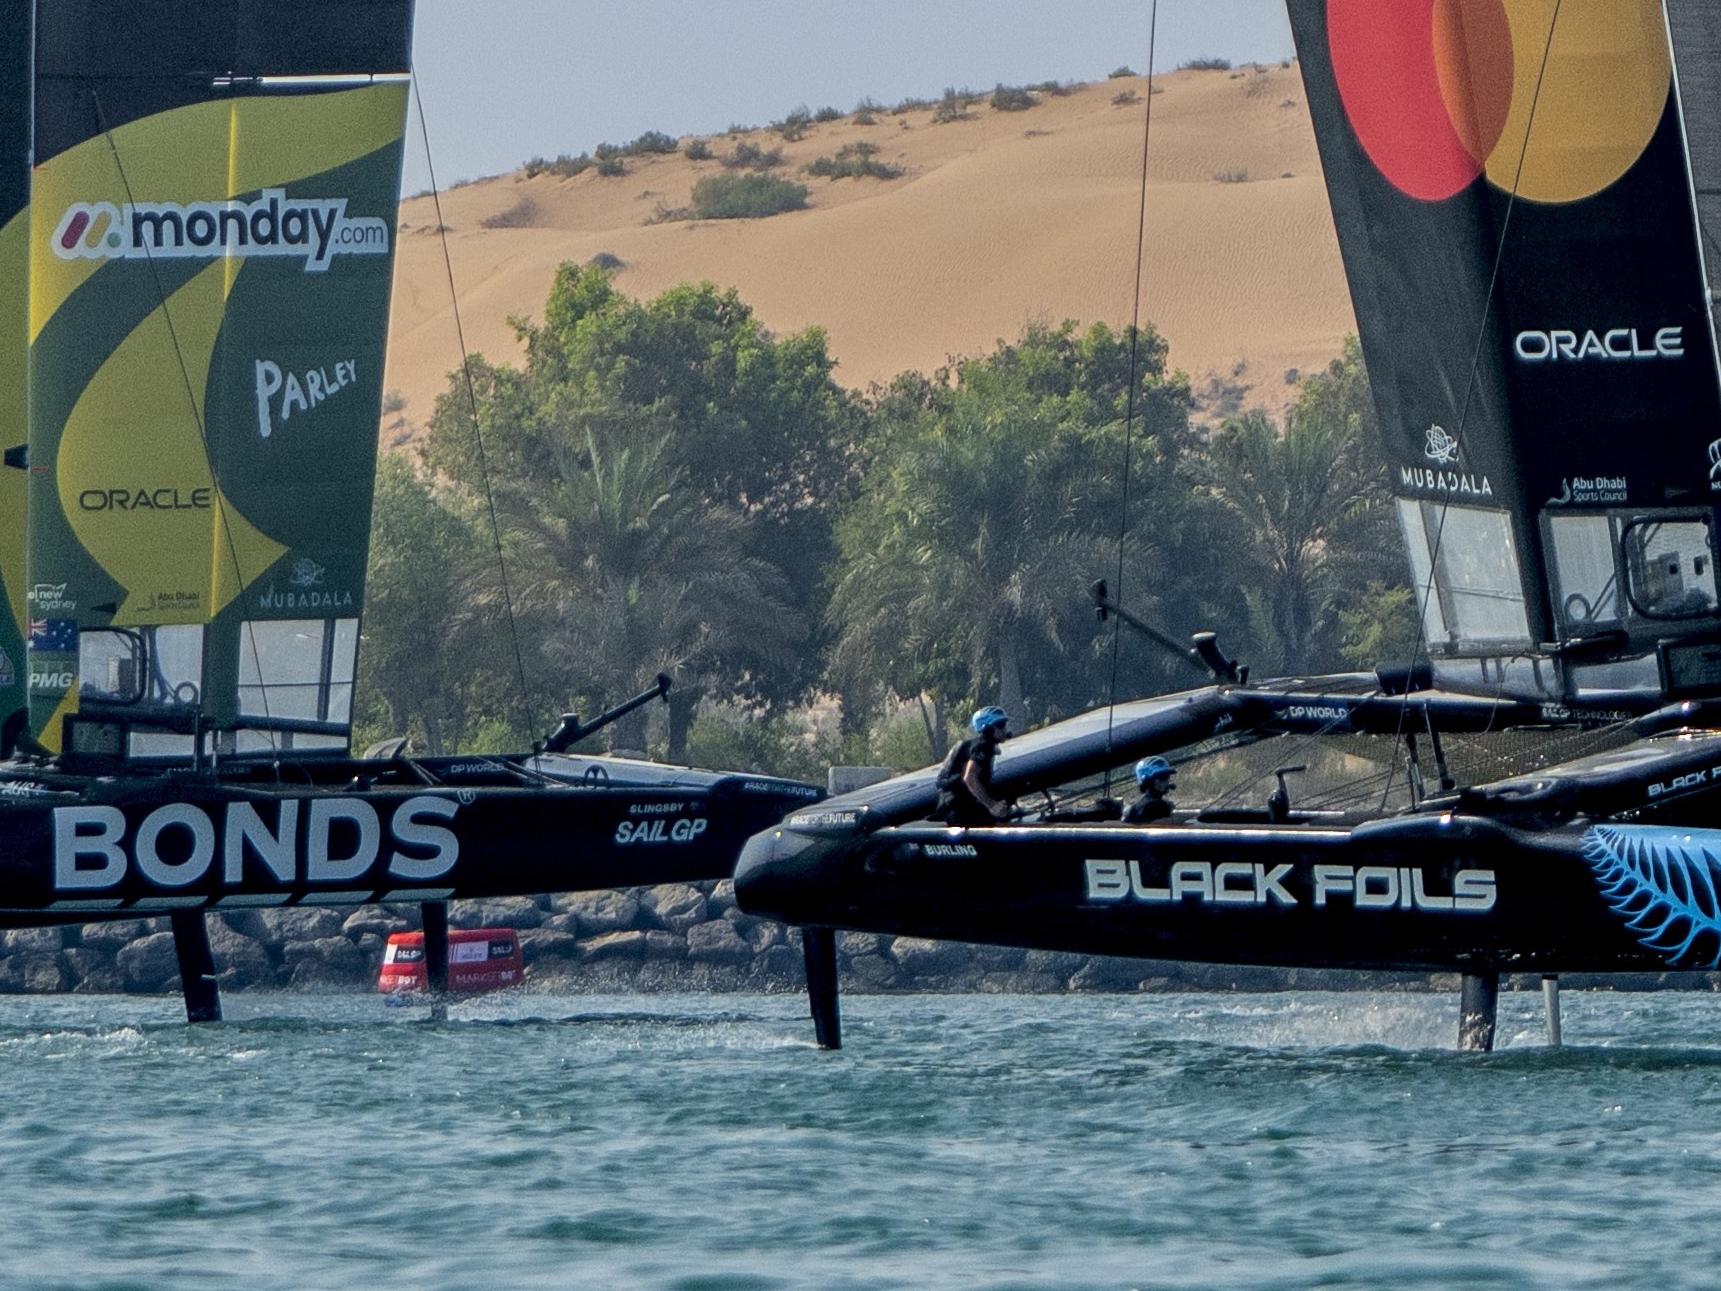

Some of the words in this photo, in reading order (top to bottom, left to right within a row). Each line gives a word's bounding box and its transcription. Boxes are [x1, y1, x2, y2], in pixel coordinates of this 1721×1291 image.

[132, 198, 385, 262] monday.com
[1516, 327, 1684, 359] ORACLE
[1401, 466, 1492, 495] MUBADALA
[1573, 478, 1593, 489] Abu
[1596, 477, 1626, 488] Dhabi
[80, 488, 211, 510] ORACLE
[1573, 491, 1598, 501] Sports
[1600, 490, 1627, 501] Council
[39, 599, 76, 611] sydney
[260, 590, 353, 608] MUBADALA
[29, 672, 75, 688] PMG
[1289, 706, 1306, 718] DP
[1308, 707, 1348, 719] WORLD
[1648, 770, 1707, 797] BLACK
[630, 803, 684, 814] SLINGSBY
[924, 844, 977, 856] BURLING
[1085, 859, 1297, 905] BLACK
[1314, 864, 1497, 911] FOILS
